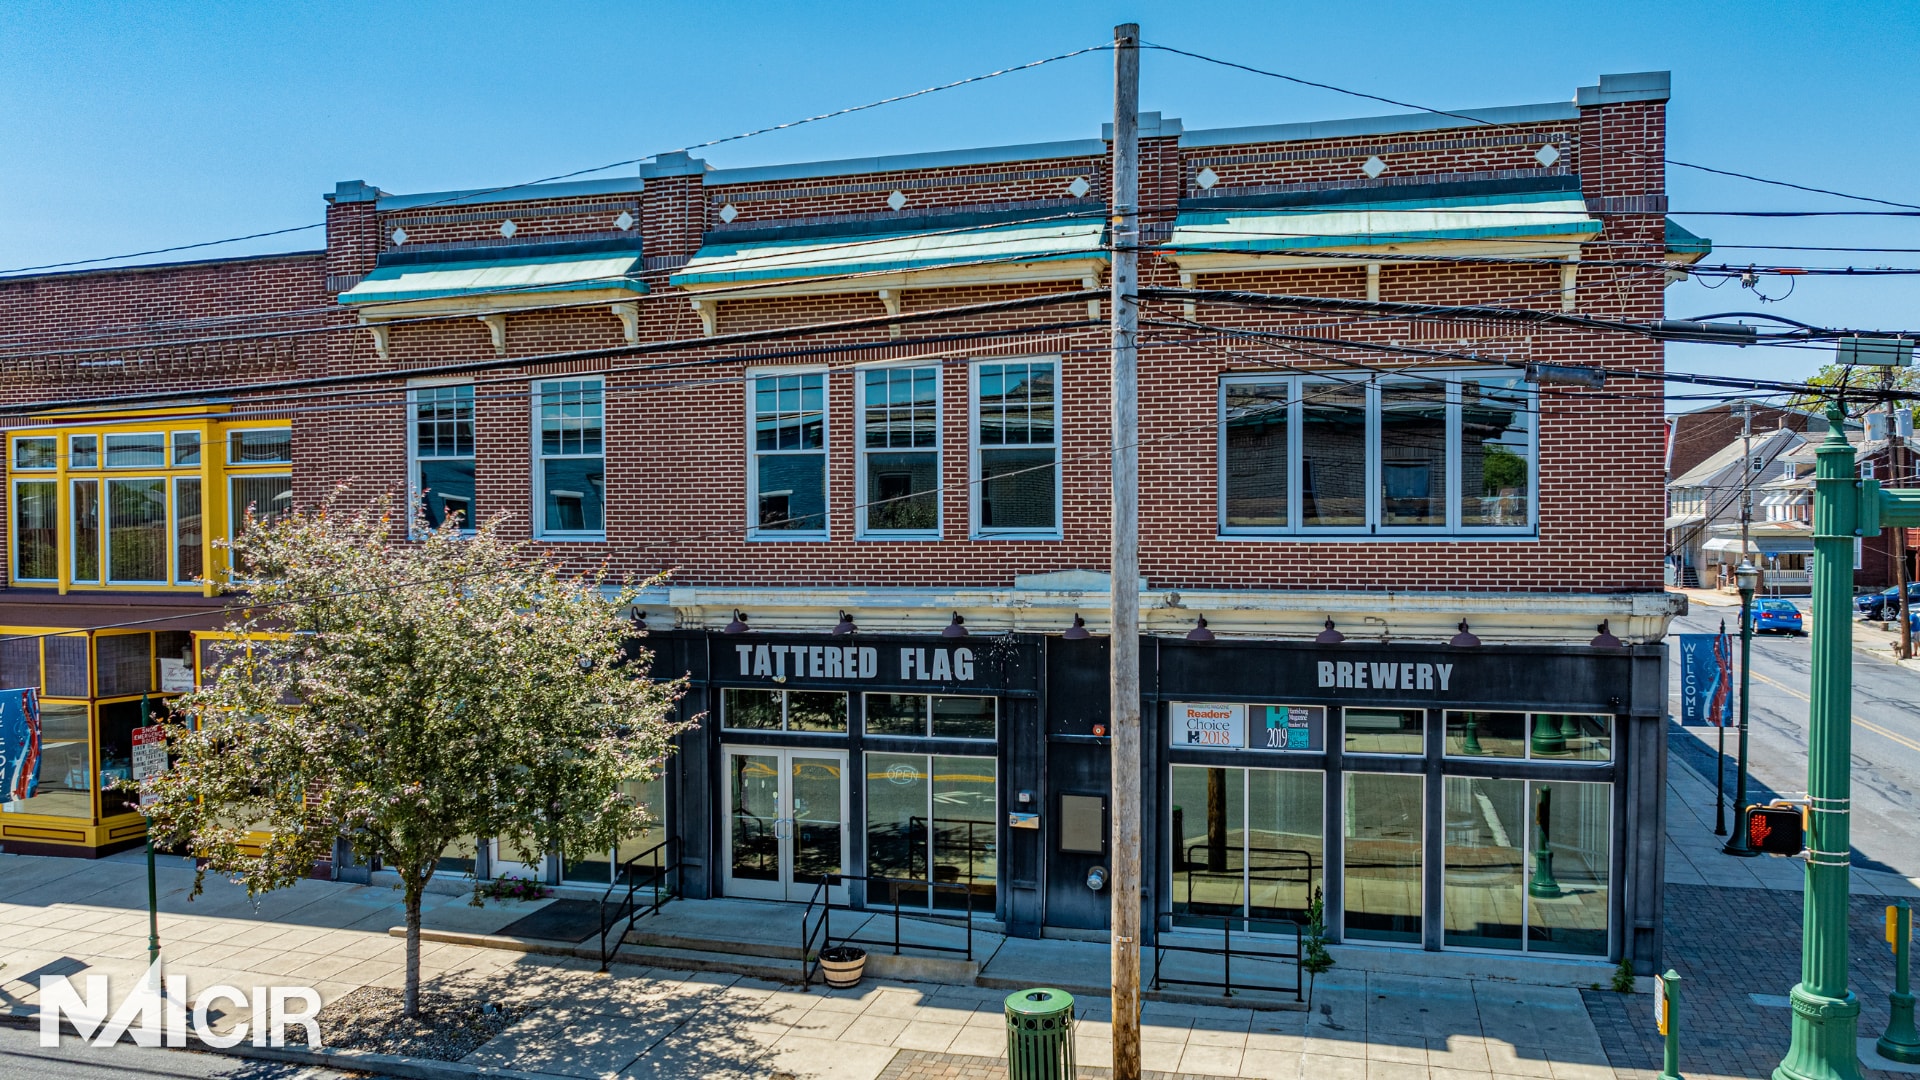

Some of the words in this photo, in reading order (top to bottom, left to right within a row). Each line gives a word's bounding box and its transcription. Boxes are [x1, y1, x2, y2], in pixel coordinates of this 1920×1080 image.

[735, 644, 878, 679] TATTERED
[900, 647, 974, 681] FLAG
[1317, 661, 1454, 691] BREWERY
[1682, 642, 1697, 717] WELCOME
[1187, 709, 1232, 719] Readers'
[1187, 718, 1230, 731] Choice
[1200, 730, 1230, 745] 2018
[1267, 727, 1288, 748] 2019
[886, 768, 919, 781] OPEN
